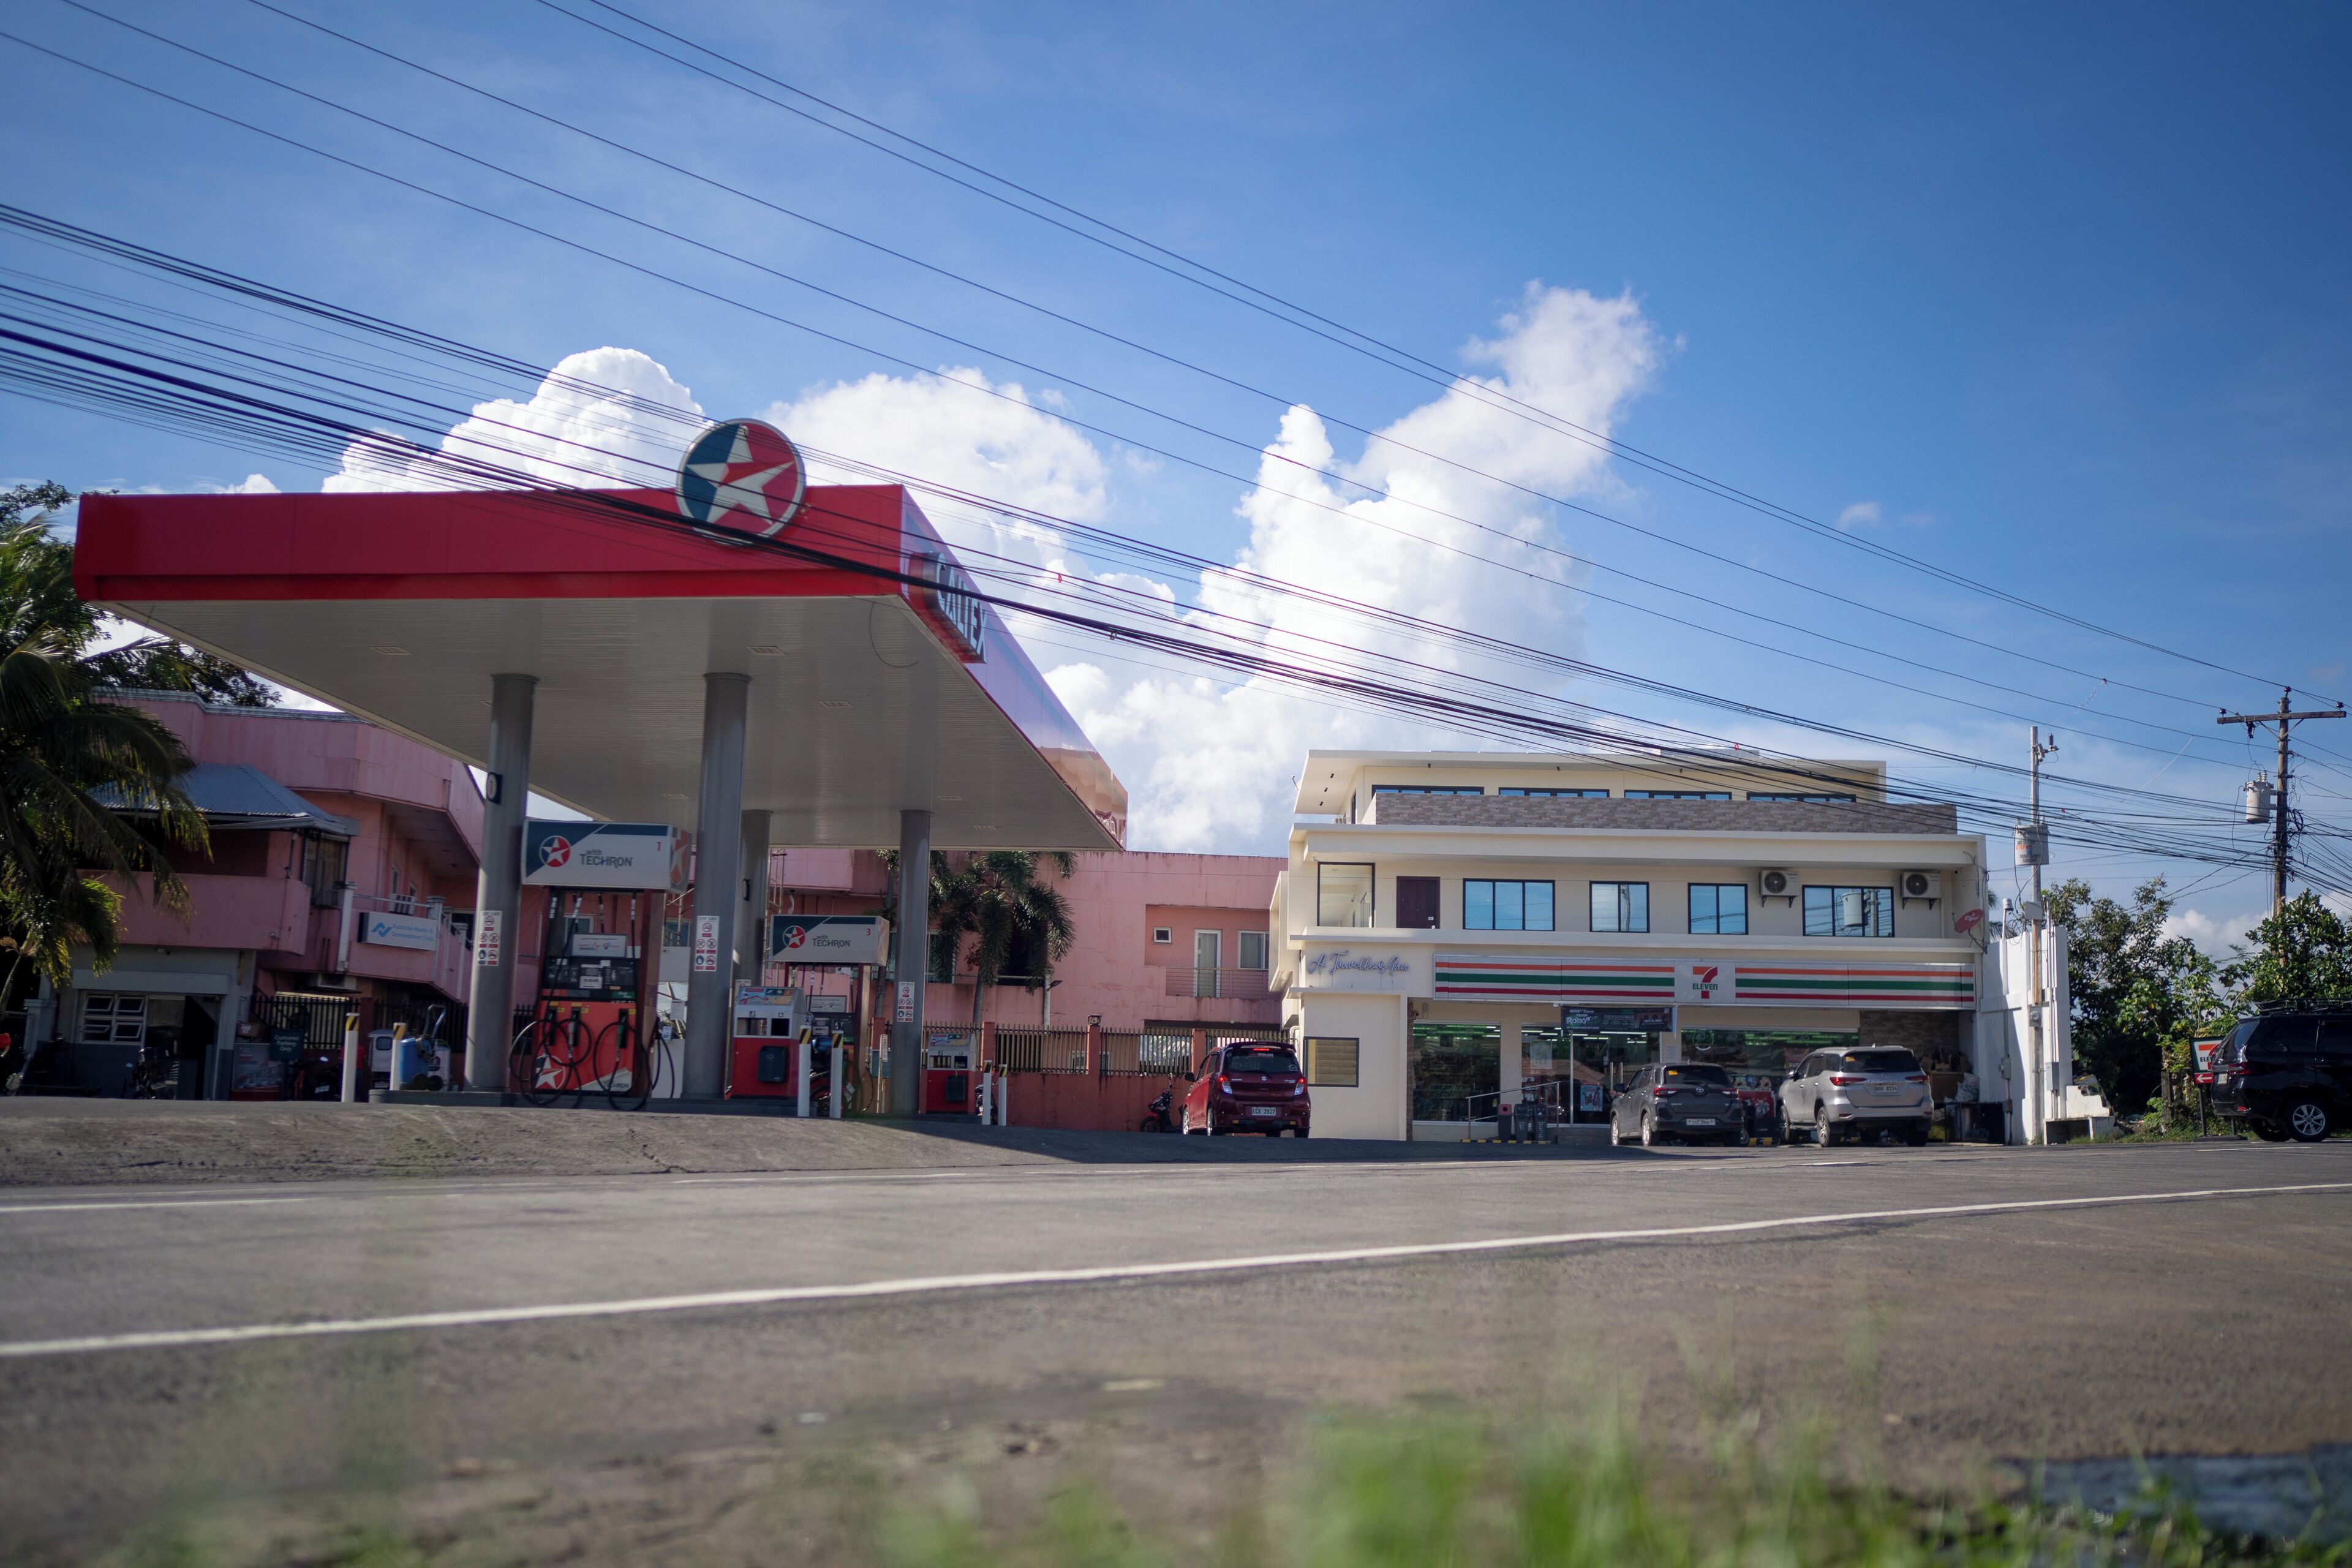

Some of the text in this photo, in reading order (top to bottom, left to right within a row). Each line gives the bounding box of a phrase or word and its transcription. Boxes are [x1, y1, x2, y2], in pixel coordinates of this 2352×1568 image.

[937, 552, 988, 663] CALTEX
[656, 842, 661, 851] 1
[579, 854, 633, 869] TECHRON
[812, 938, 851, 948] TECHRON
[1307, 953, 1327, 975] A
[1388, 956, 1409, 976] Inn
[1693, 966, 1718, 999] 7
